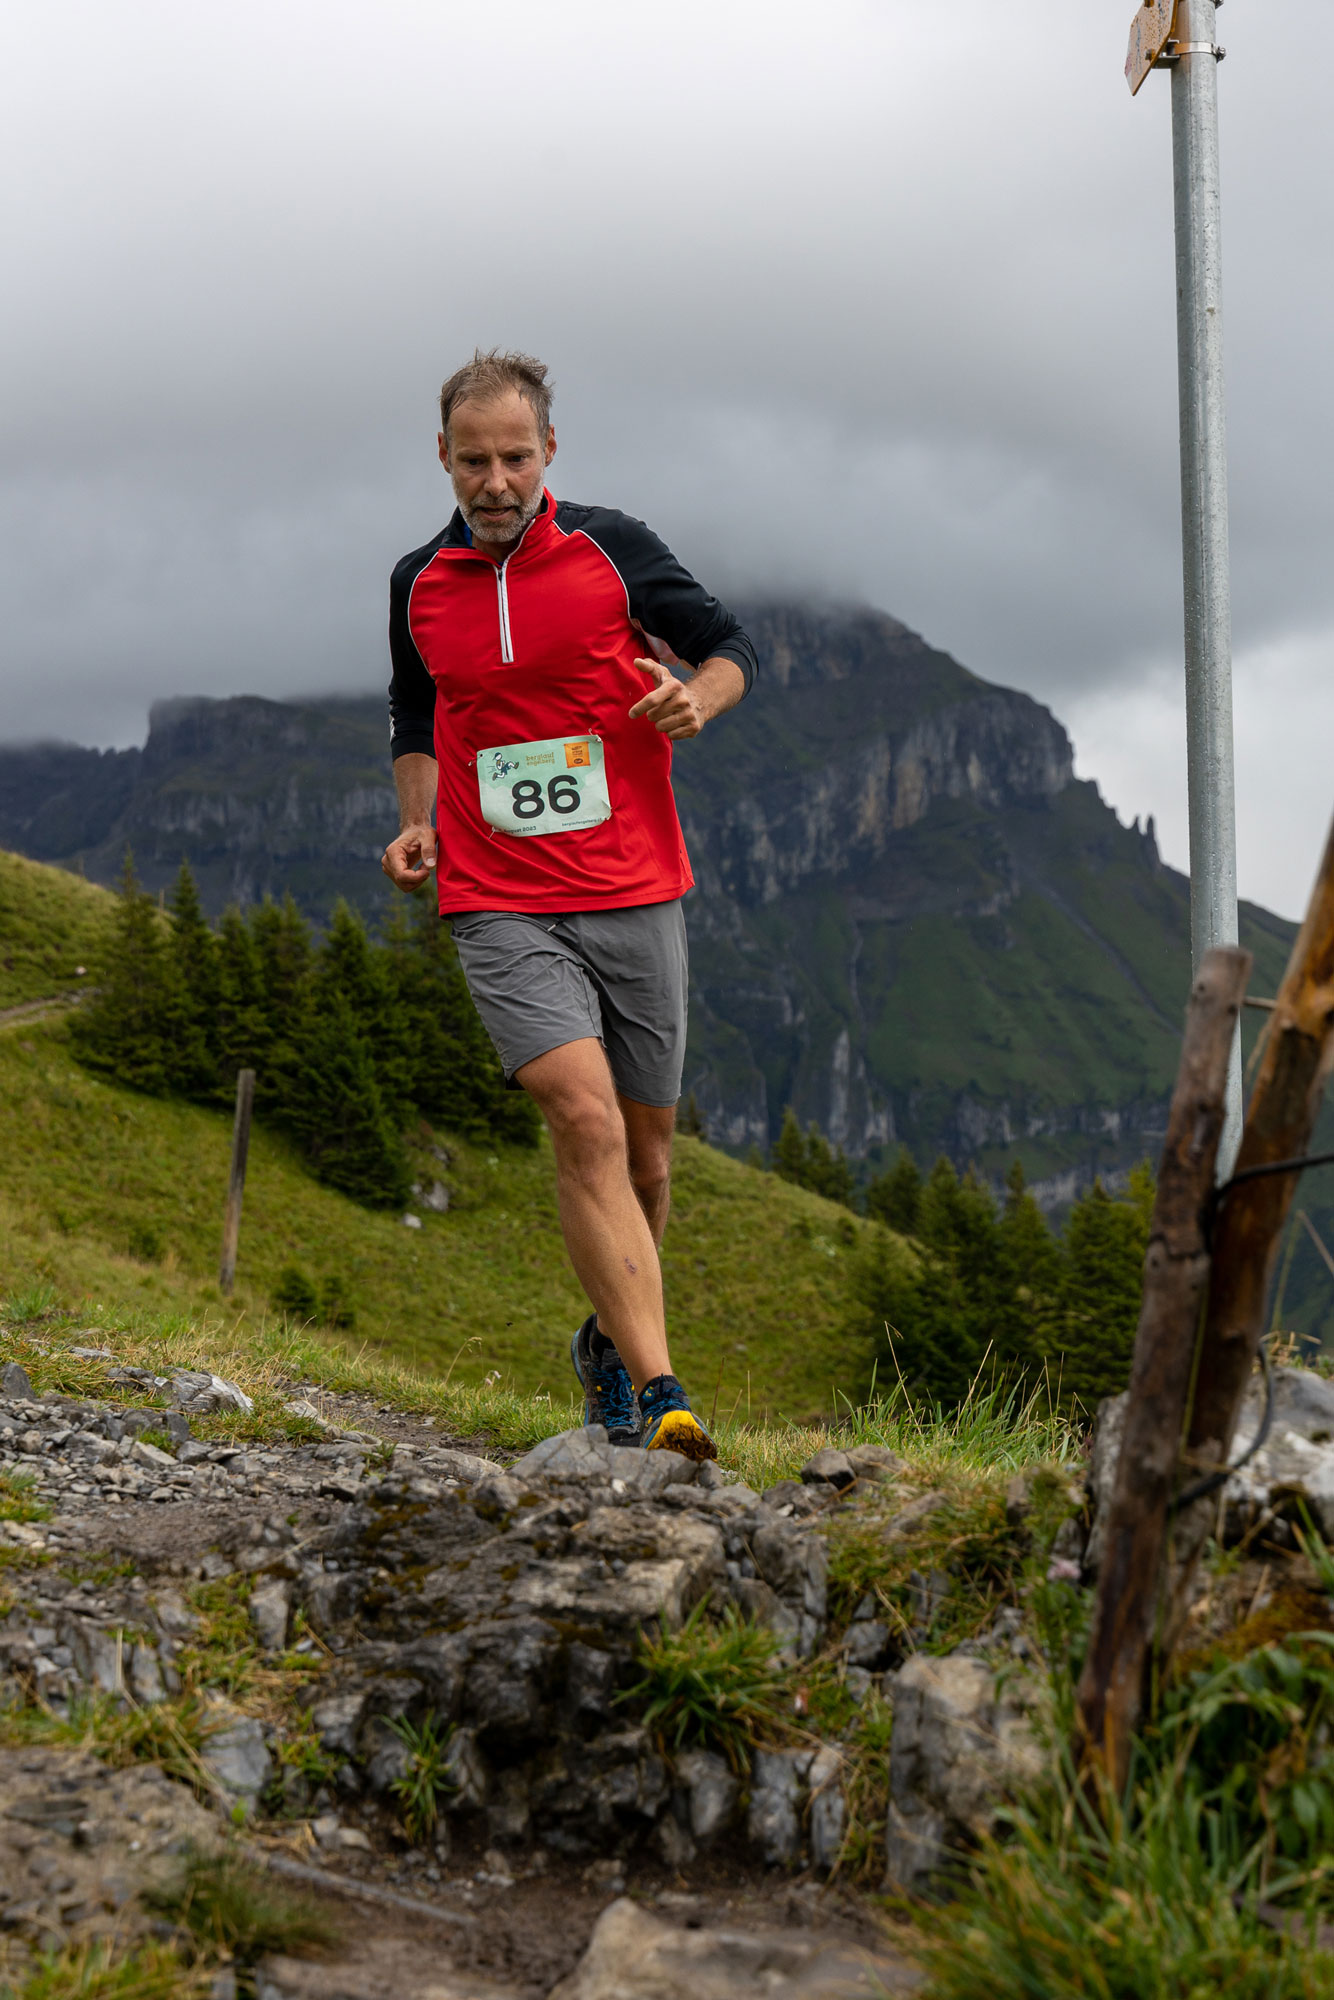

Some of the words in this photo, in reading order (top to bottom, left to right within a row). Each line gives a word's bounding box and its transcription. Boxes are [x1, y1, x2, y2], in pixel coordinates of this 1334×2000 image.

[526, 752, 554, 761] berglauf
[527, 758, 555, 766] engelberg
[512, 775, 581, 819] 86
